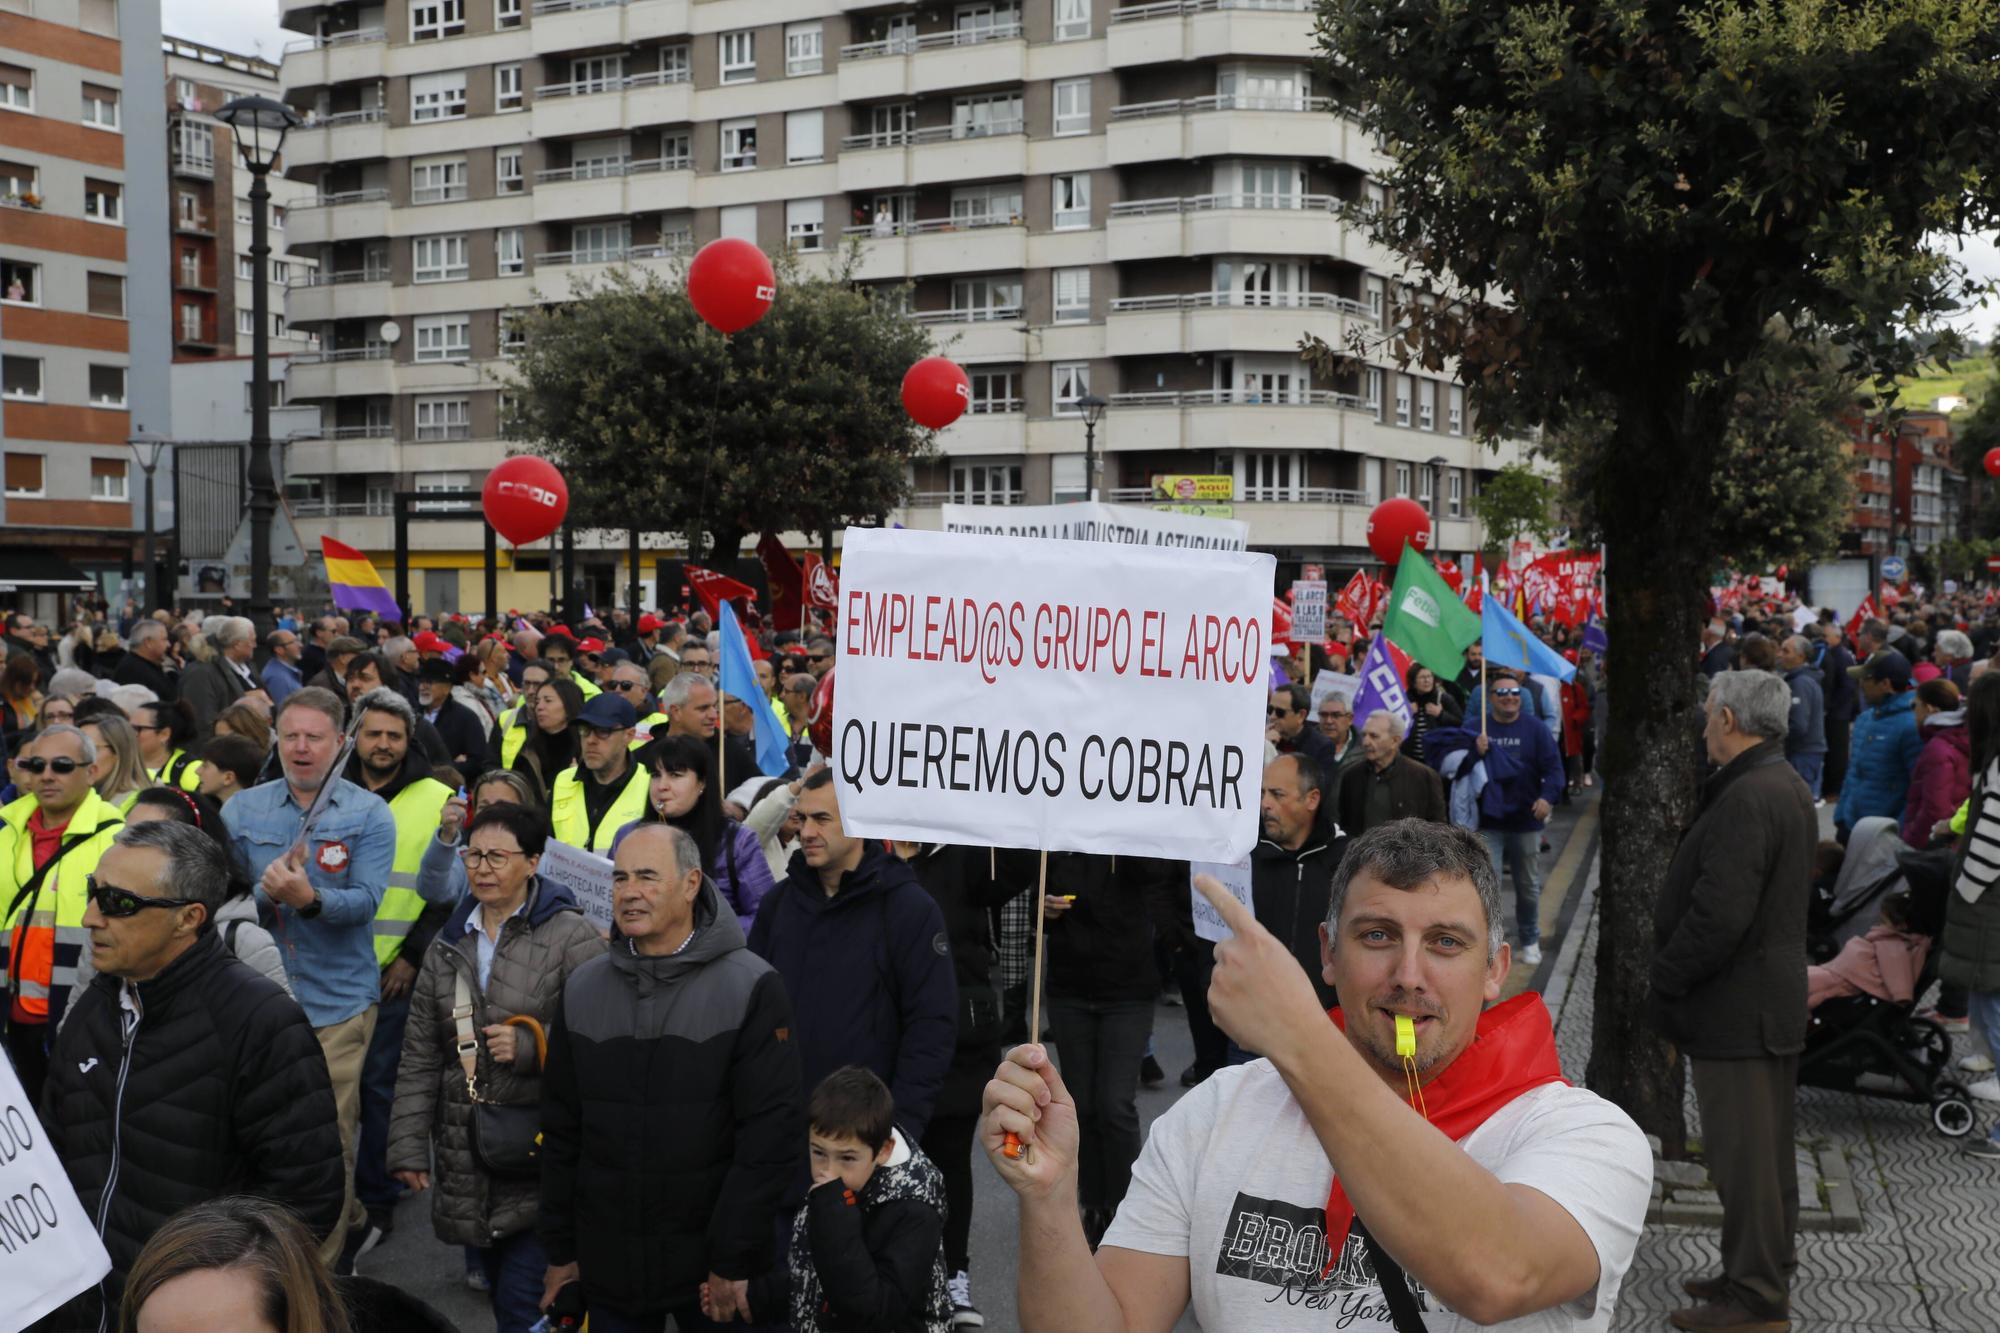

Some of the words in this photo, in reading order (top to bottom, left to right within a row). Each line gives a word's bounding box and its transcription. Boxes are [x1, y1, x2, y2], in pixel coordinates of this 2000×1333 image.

[847, 591, 1025, 684] EMPLEAD@S
[1034, 603, 1131, 674] GRUPO
[1140, 611, 1172, 678] EL
[1180, 615, 1260, 685] ARCO
[840, 719, 1067, 798] QUEREMOS
[1079, 735, 1244, 810] COBRAR
[0, 1106, 32, 1166] DO
[1228, 1211, 1379, 1288] BROOK
[1265, 1279, 1337, 1310] New
